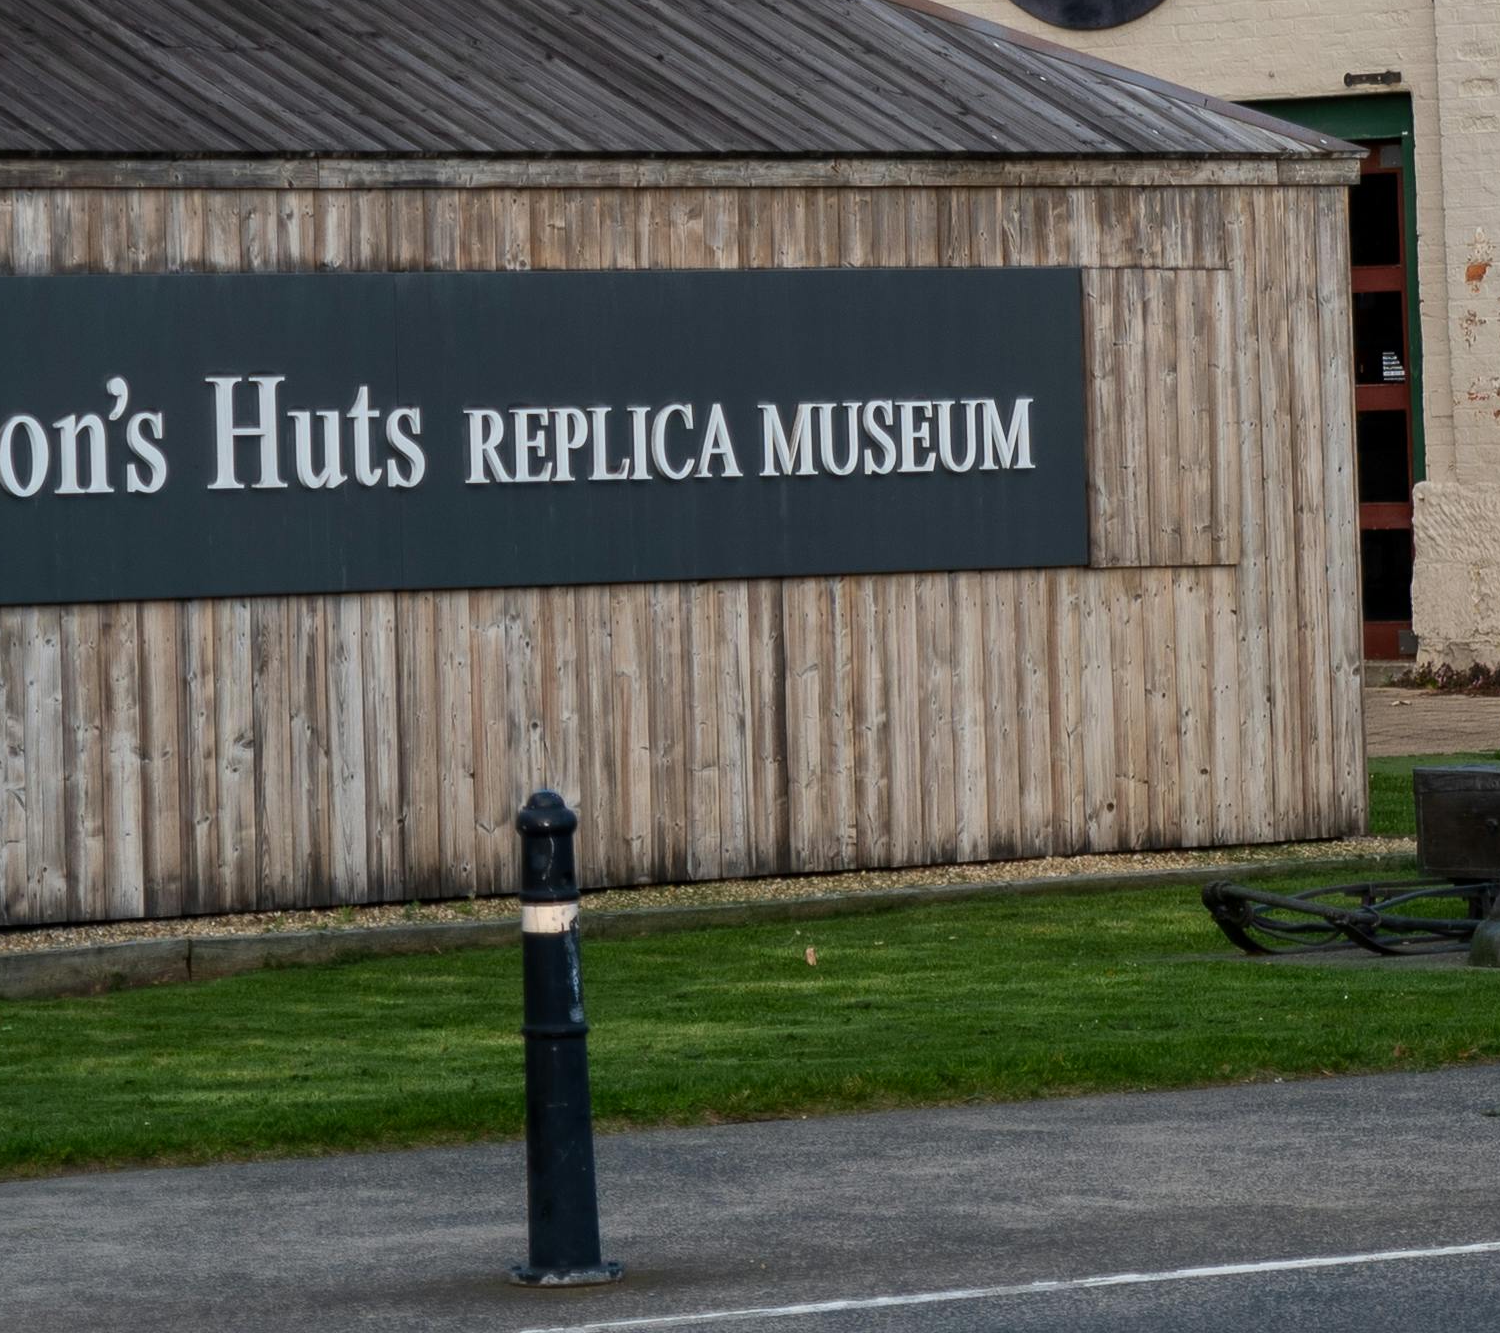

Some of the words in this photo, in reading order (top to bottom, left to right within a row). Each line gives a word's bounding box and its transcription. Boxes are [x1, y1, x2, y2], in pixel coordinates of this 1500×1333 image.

[205, 375, 426, 490] Huts
[463, 403, 743, 484] REPLICA
[758, 398, 1036, 476] MUSEUM
